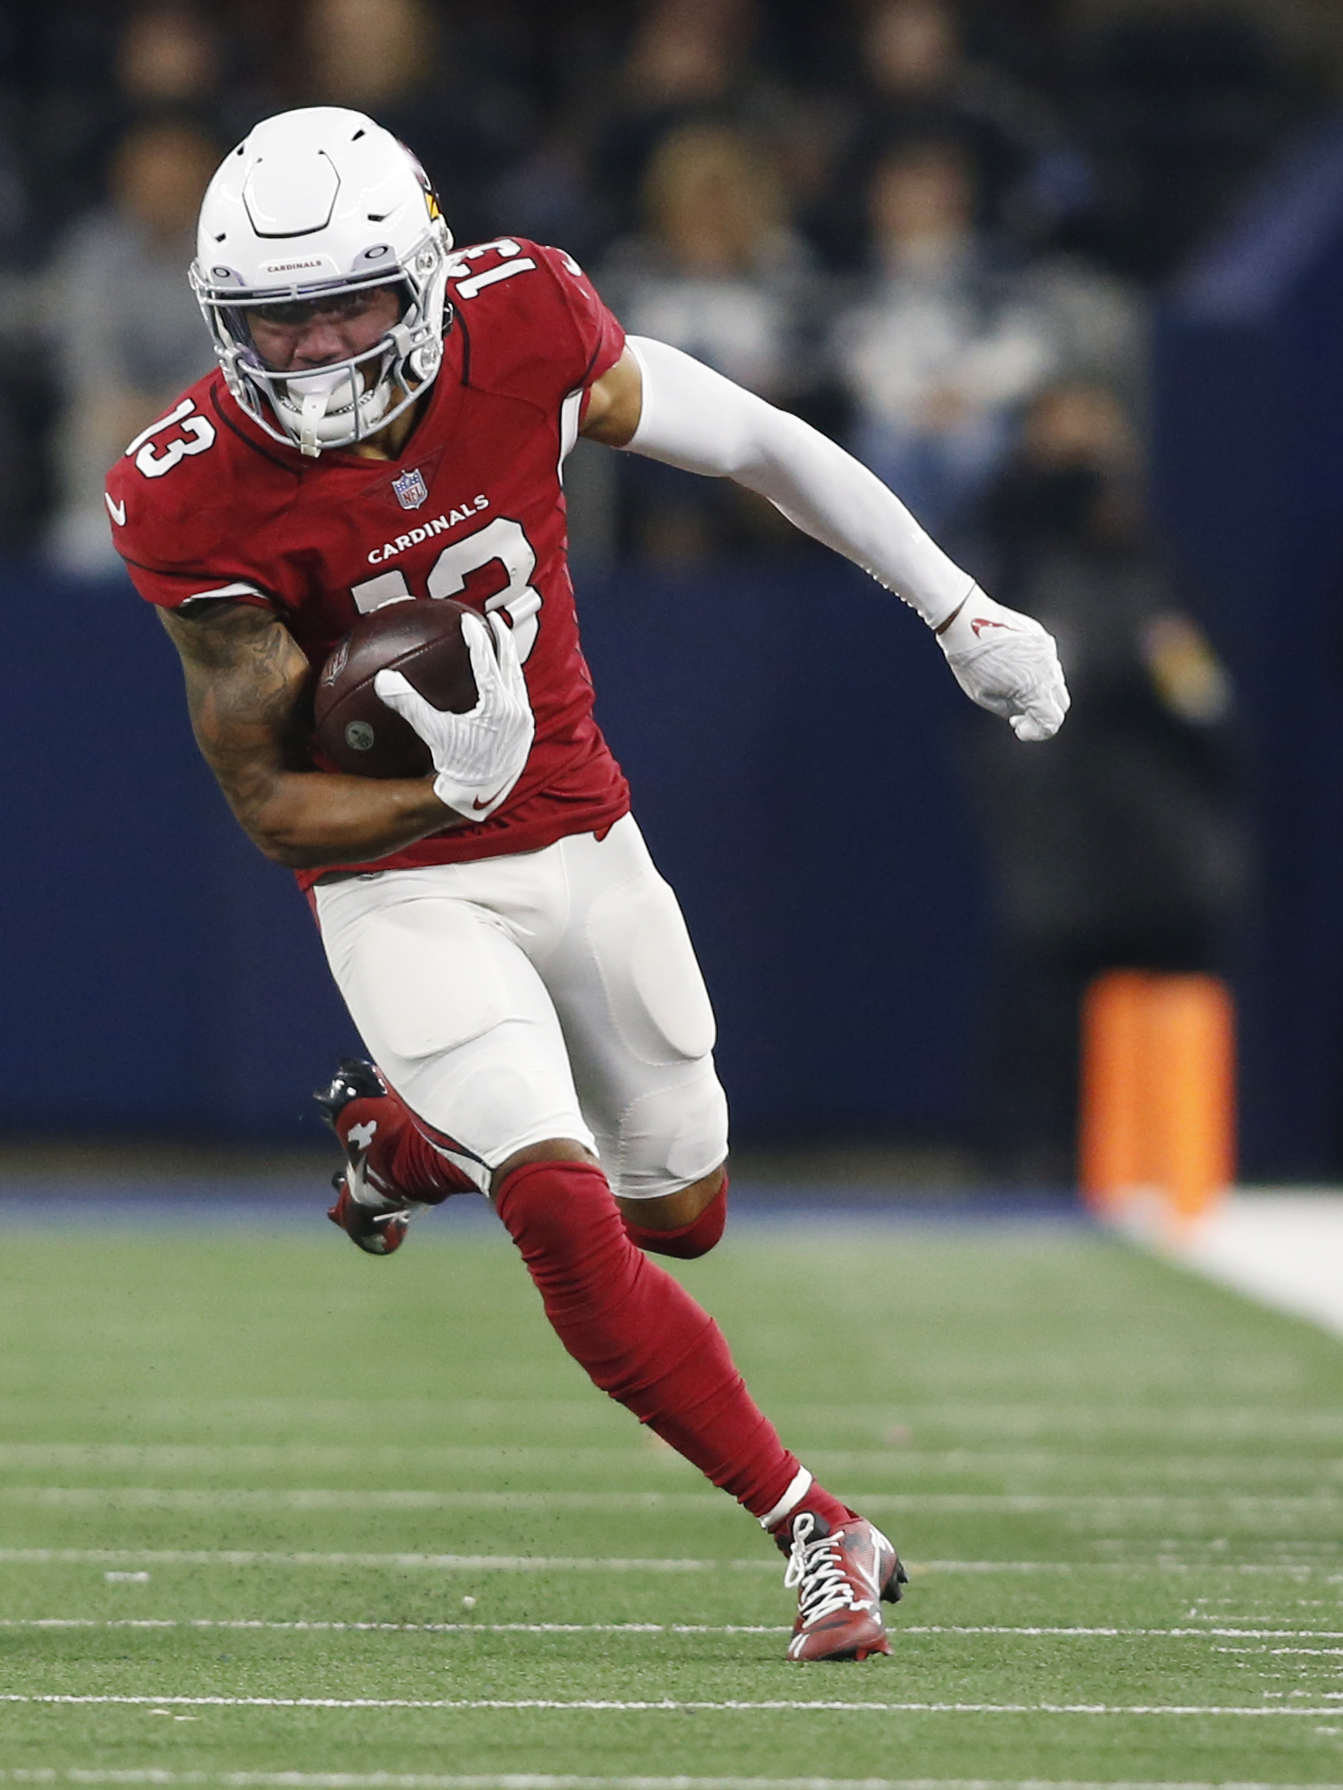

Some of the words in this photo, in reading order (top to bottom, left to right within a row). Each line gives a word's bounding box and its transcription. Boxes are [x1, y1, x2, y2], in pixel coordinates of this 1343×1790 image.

[267, 260, 322, 273] CARDINALS
[125, 397, 217, 479] 13
[402, 484, 424, 504] NFL
[367, 494, 490, 564] CARDINALS
